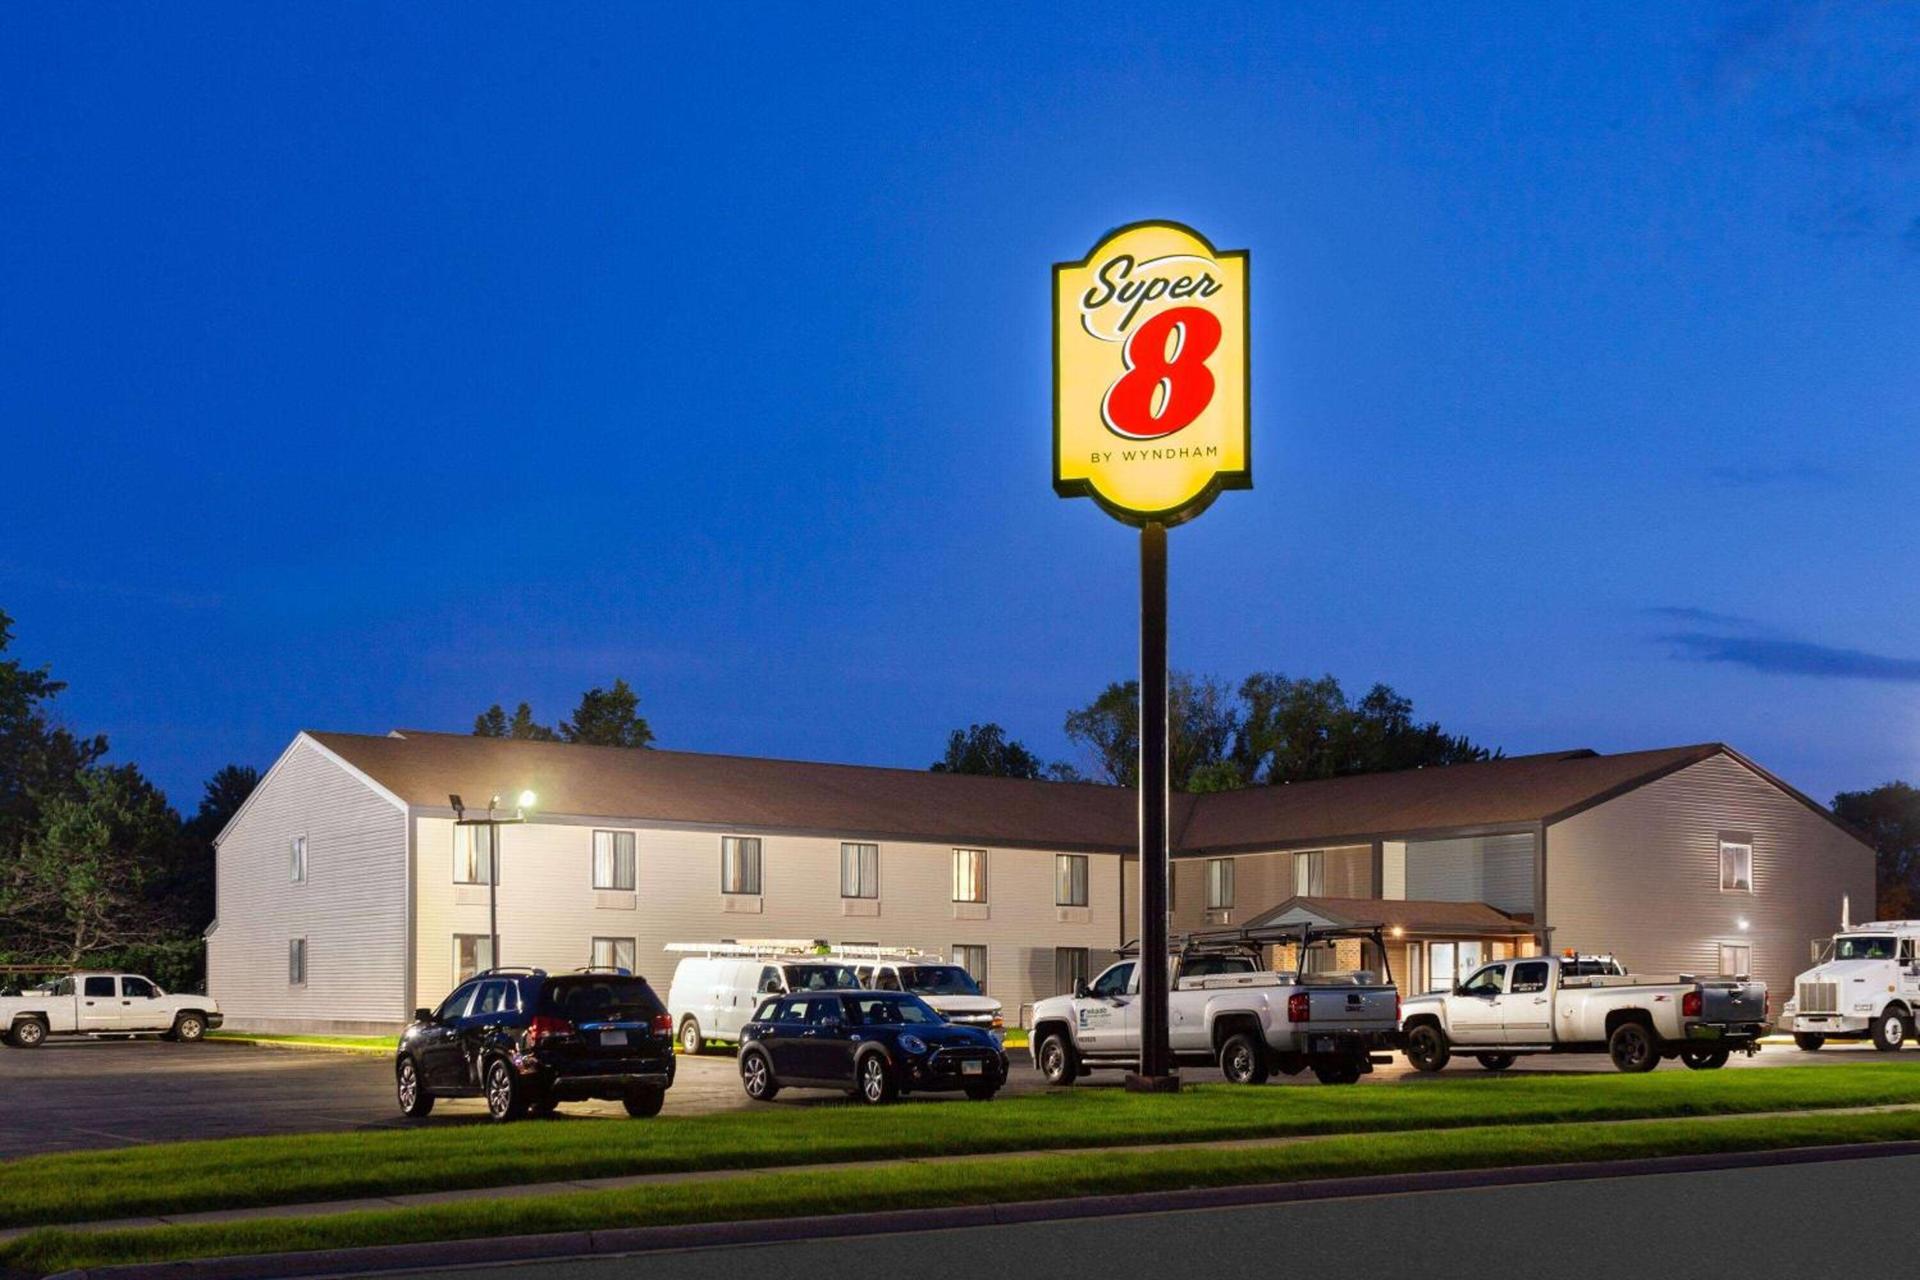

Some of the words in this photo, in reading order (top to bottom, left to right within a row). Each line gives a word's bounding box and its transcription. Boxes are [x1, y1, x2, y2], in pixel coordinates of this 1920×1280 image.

[1083, 254, 1223, 332] Super
[1101, 306, 1223, 440] 8
[1091, 452, 1112, 463] BY
[1122, 446, 1217, 461] WYNDHAM
